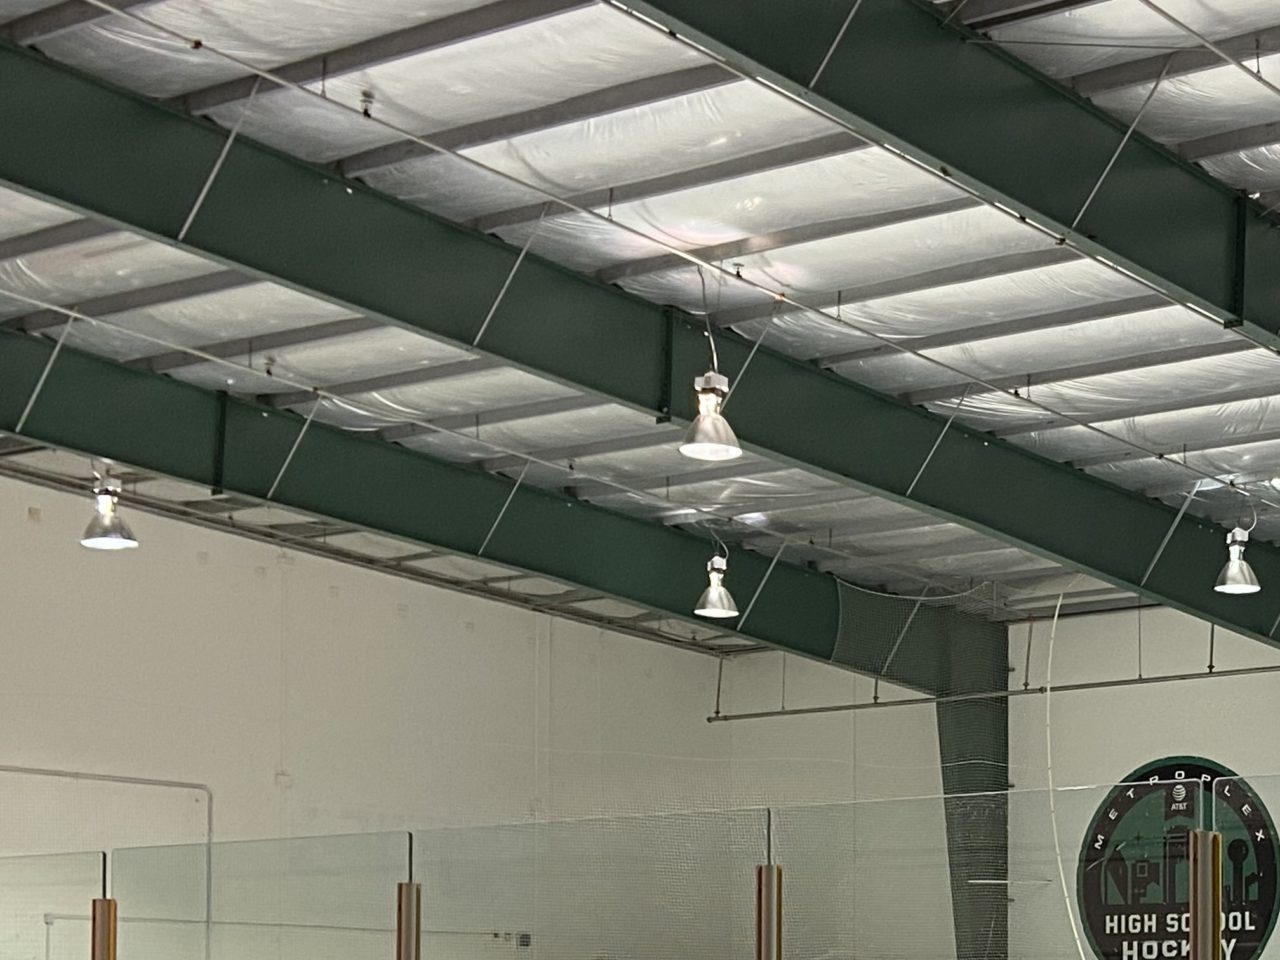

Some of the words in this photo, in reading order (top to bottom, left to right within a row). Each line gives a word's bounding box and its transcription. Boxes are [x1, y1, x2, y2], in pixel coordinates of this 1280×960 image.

[1171, 802, 1188, 811] AT&T
[1105, 913, 1157, 934] HIGH
[1166, 911, 1256, 934] SCOL
